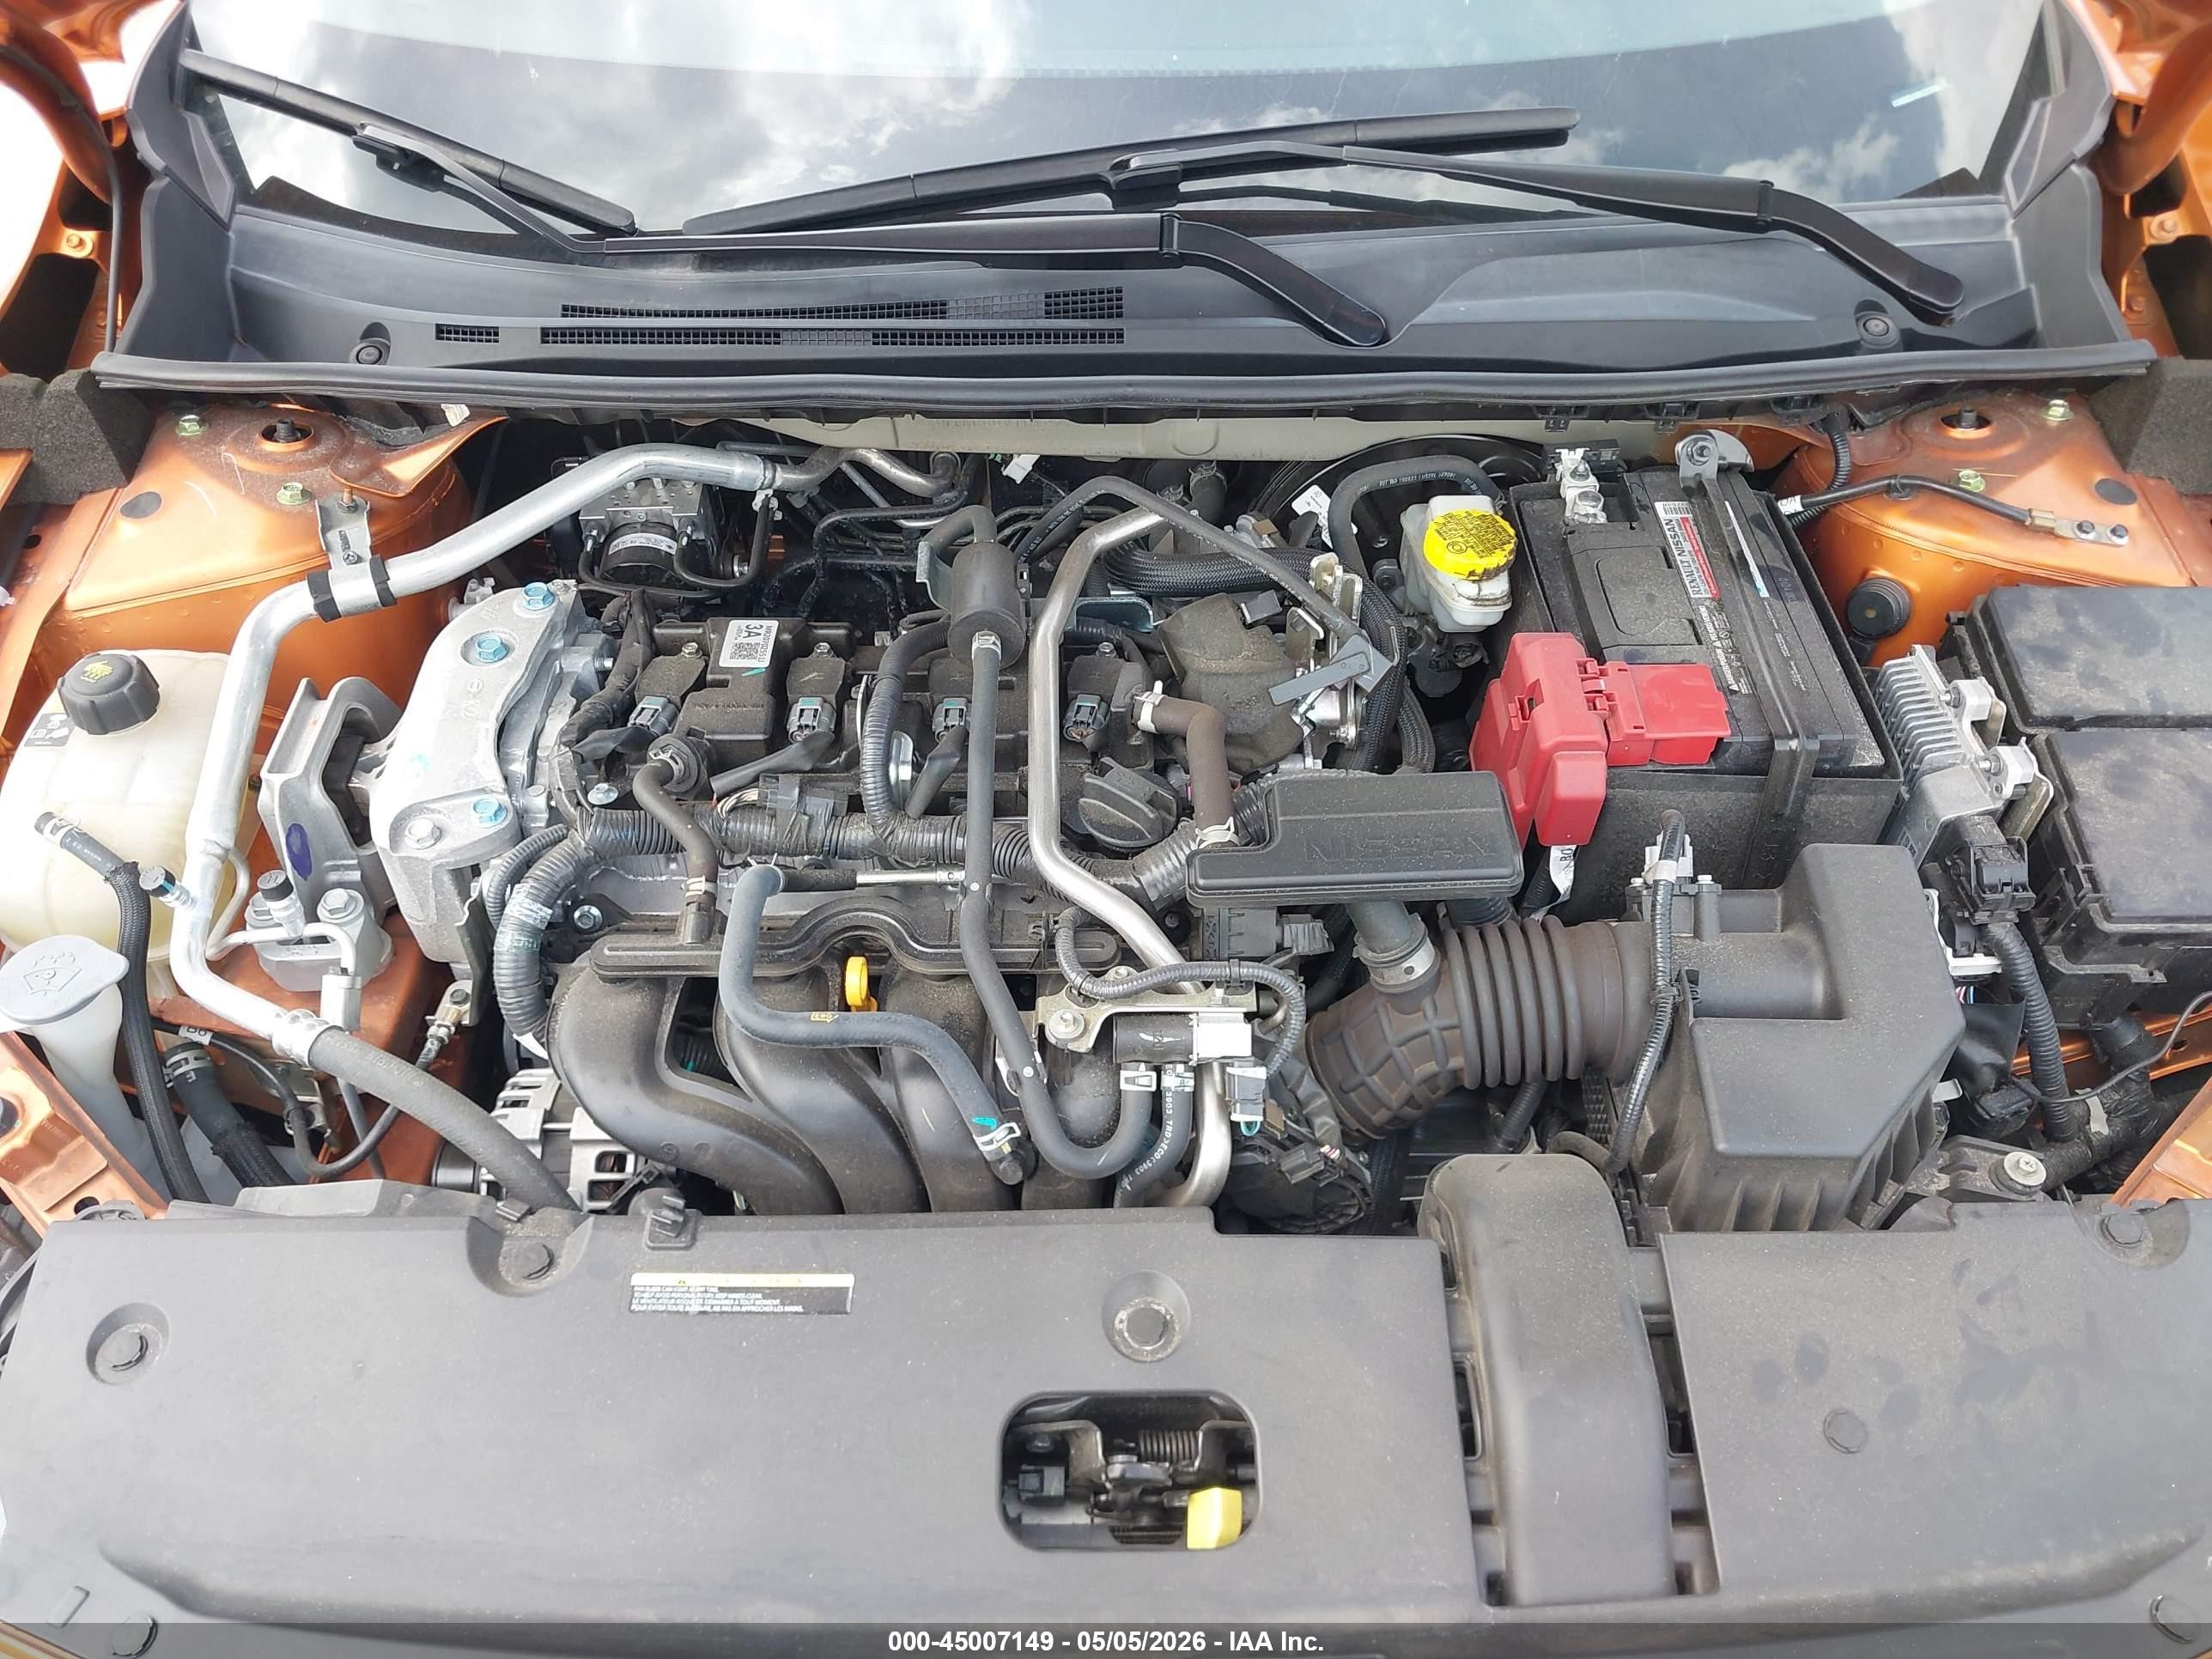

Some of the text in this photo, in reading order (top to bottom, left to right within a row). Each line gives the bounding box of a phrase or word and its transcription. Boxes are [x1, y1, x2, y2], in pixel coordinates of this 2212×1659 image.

[1665, 518, 1686, 557] NISSAN
[1682, 560, 1703, 596] RENAULT
[742, 624, 763, 639] 3A
